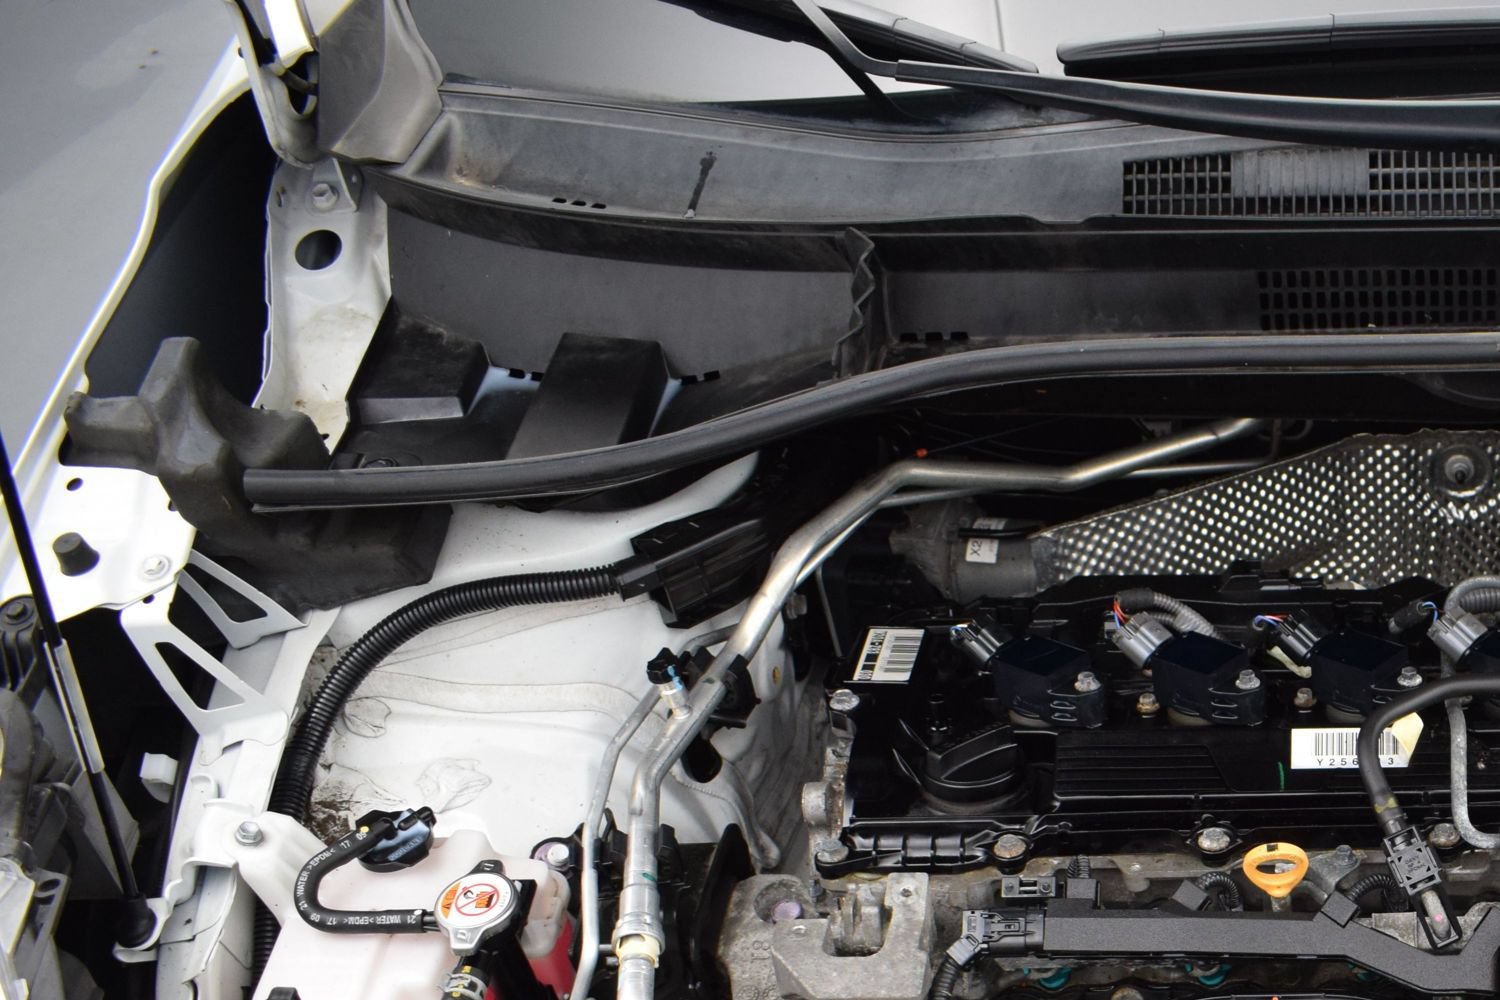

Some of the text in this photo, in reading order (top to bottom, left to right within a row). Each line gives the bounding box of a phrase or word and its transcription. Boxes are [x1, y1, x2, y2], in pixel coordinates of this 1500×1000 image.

[296, 870, 310, 898] WATER
[340, 839, 352, 849] 17
[375, 914, 402, 925] WATER
